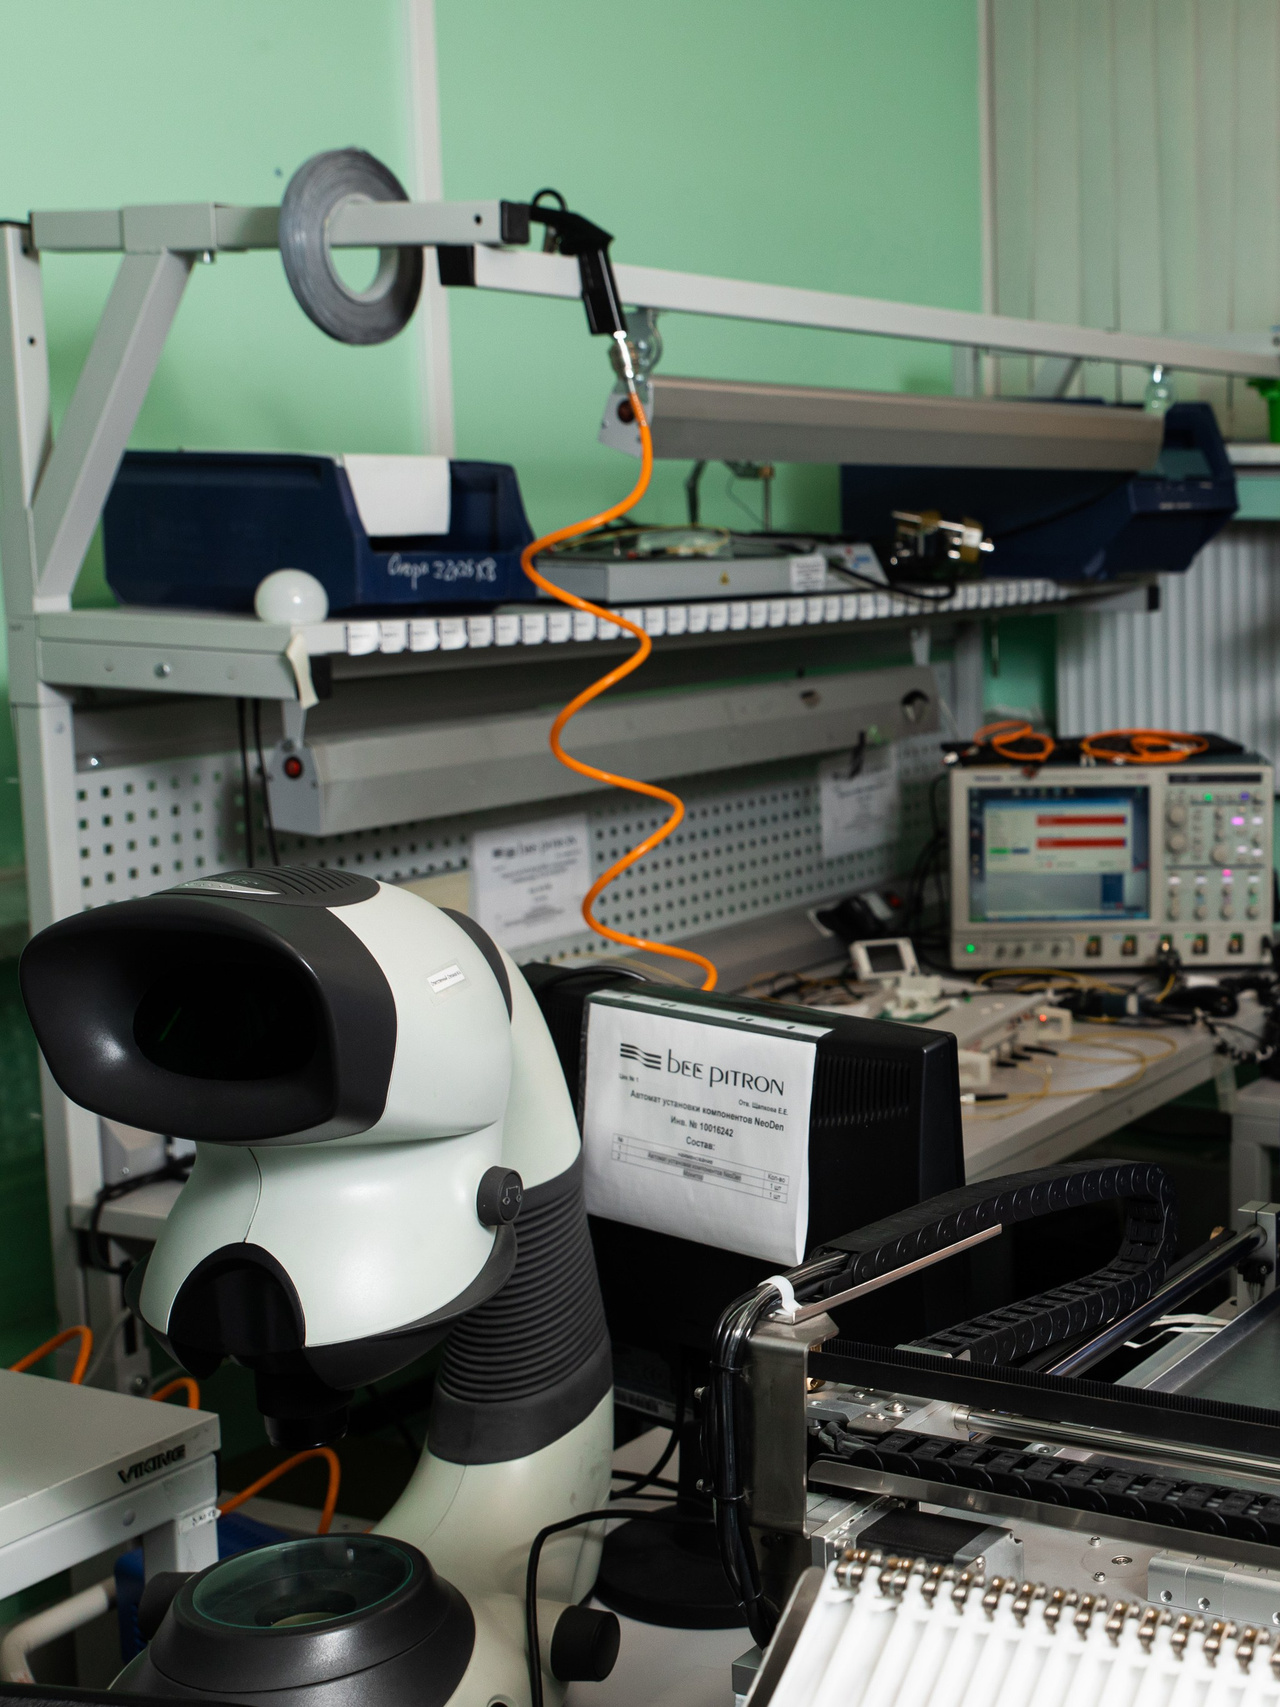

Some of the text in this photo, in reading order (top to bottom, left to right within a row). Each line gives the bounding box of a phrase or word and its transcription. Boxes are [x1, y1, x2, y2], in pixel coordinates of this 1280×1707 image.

[630, 1090, 784, 1131] Автомат установки компонентов NeoDen
[670, 1116, 734, 1137] Инв. № 10016242
[686, 1136, 715, 1151] Состав:
[117, 1444, 186, 1484] VIKING
